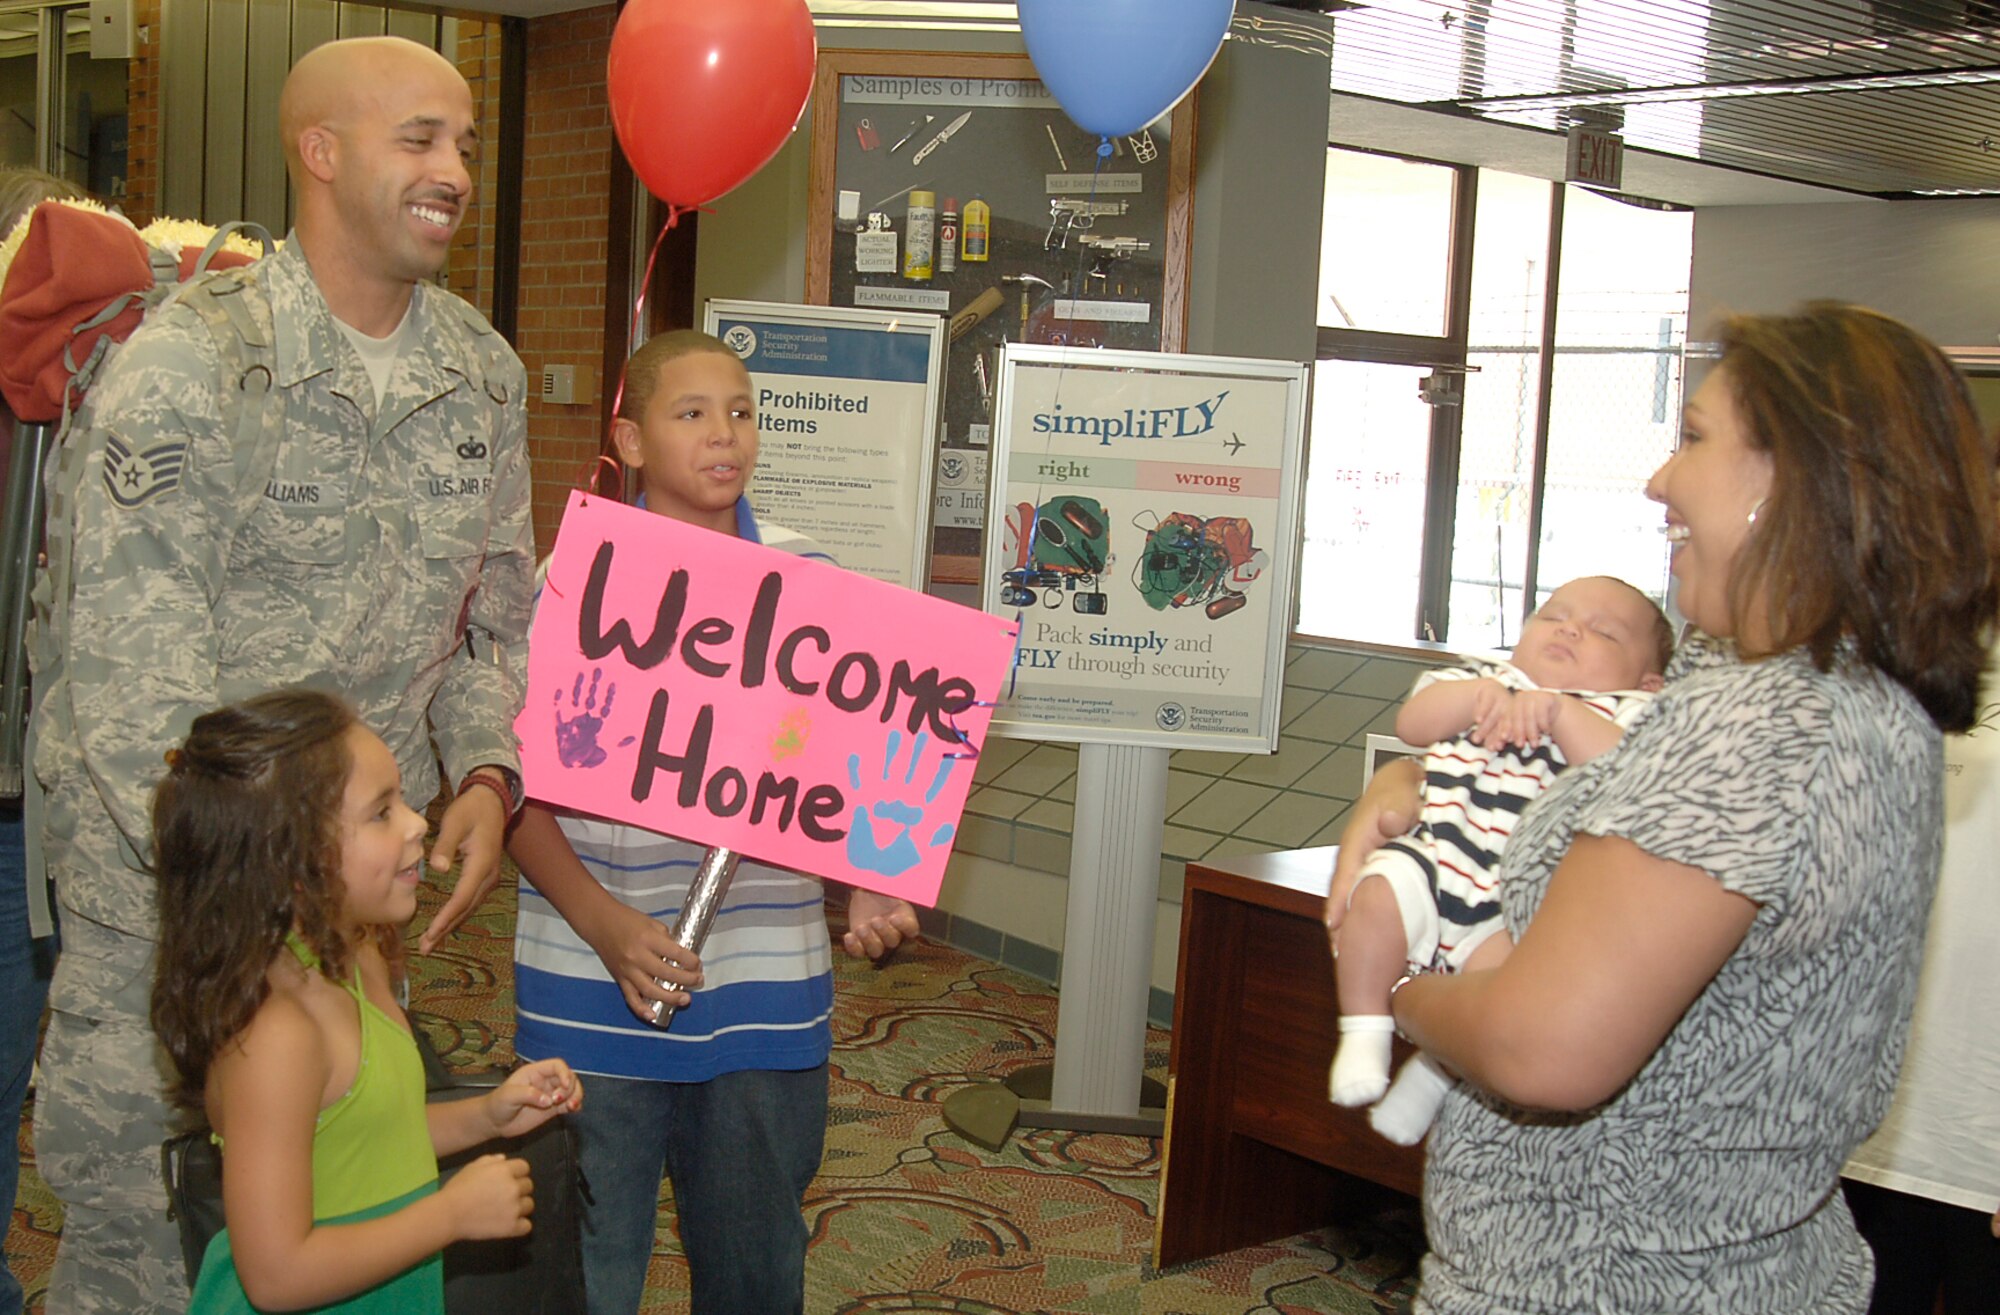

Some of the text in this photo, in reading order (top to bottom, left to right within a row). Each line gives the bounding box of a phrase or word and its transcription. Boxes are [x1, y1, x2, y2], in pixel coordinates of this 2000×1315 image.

[851, 76, 943, 100] Samples
[950, 79, 971, 96] of
[1577, 134, 1621, 183] EXIT
[1050, 180, 1069, 188] SELF
[1113, 179, 1139, 187] ITEMS
[859, 292, 945, 304] FLAMMABLE ITEMS
[763, 331, 828, 343] Transportation
[762, 341, 798, 351] Security
[762, 350, 828, 362] Administration
[759, 389, 869, 414] Prohibited
[758, 413, 818, 434] Items
[1033, 390, 1230, 446] simpliFLY
[785, 452, 811, 461] beyond
[804, 444, 822, 452] bring
[837, 446, 868, 456] following
[869, 448, 889, 457] types
[753, 475, 790, 483] FLAMMABLE
[802, 479, 836, 487] EXPLOSIVE
[838, 481, 872, 489] MATERIALS
[1038, 460, 1242, 493] right wrong
[429, 479, 458, 496] U.S.
[459, 478, 479, 495] AIR
[579, 539, 977, 744] Welcome
[1037, 622, 1213, 655] Pack simply and
[1016, 648, 1230, 686] FLY through security
[1039, 696, 1056, 704] early
[1075, 707, 1110, 715] simpliFLY
[1190, 706, 1249, 717] Transportation
[1190, 715, 1223, 725] Security
[1189, 723, 1249, 734] Administration
[631, 687, 848, 843] Home
